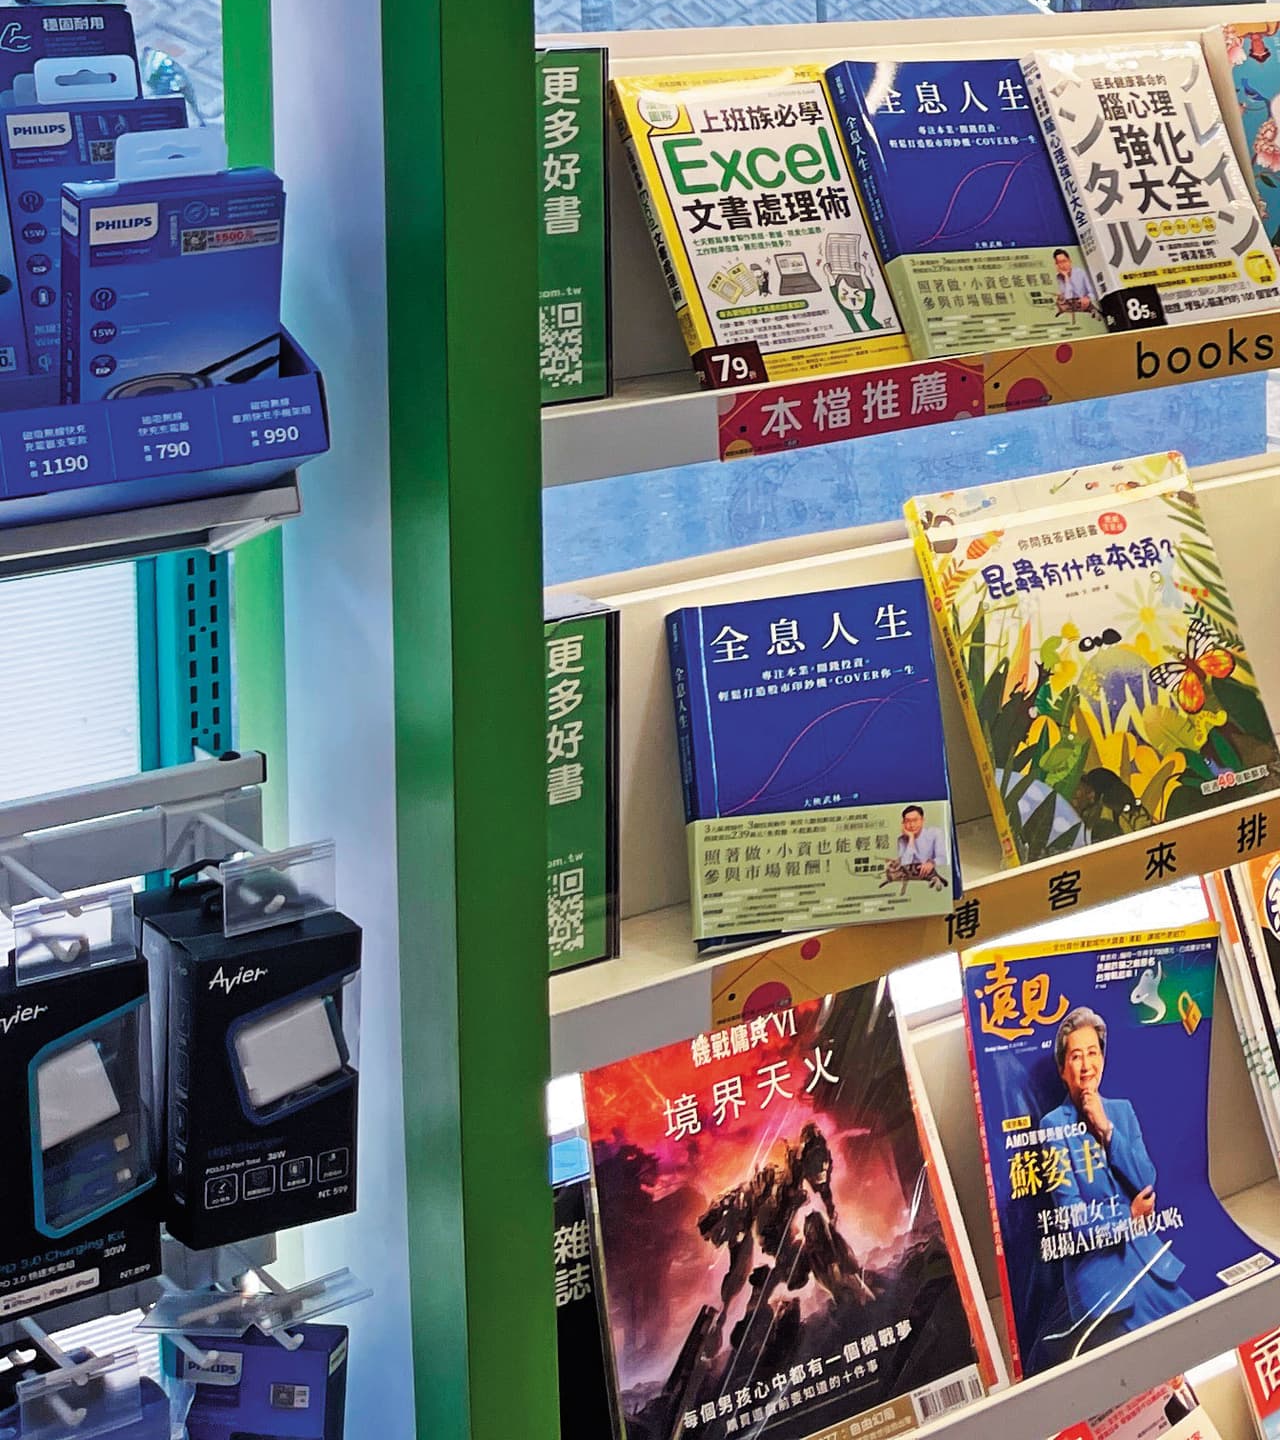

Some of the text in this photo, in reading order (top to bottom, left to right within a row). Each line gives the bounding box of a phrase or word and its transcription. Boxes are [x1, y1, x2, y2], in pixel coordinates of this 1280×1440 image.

[700, 100, 825, 134] 上班族必學
[876, 78, 1031, 116] 全息人生
[1099, 90, 1177, 121] 腦心理
[13, 122, 66, 138] PHILIPS
[541, 66, 582, 234] 更多好書
[1112, 122, 1193, 168] 強化
[662, 126, 841, 195] Excel
[682, 186, 851, 234] 文書處理術
[1130, 167, 1210, 215] 大全
[94, 216, 153, 232] PHILIPS
[92, 327, 116, 338] 15W
[761, 371, 949, 439] 本檔推薦
[155, 441, 191, 460] 790
[263, 426, 300, 445] 990
[42, 455, 89, 478] 1190
[709, 603, 914, 666] 全息人生
[546, 634, 585, 806] 更多好書
[674, 667, 690, 730] 全息人生
[704, 833, 890, 866] 照著做，小資也能輕鬆
[208, 963, 269, 995] Avier
[974, 954, 1070, 1041] 遠見
[663, 1044, 840, 1143] 境界天火
[1008, 1140, 1107, 1200] 蘇姿丰
[1037, 1194, 1123, 1235] 半導體女王
[553, 1219, 591, 1308] 雜誌
[682, 1319, 913, 1430] 每個男孩心中都有一個機戰夢
